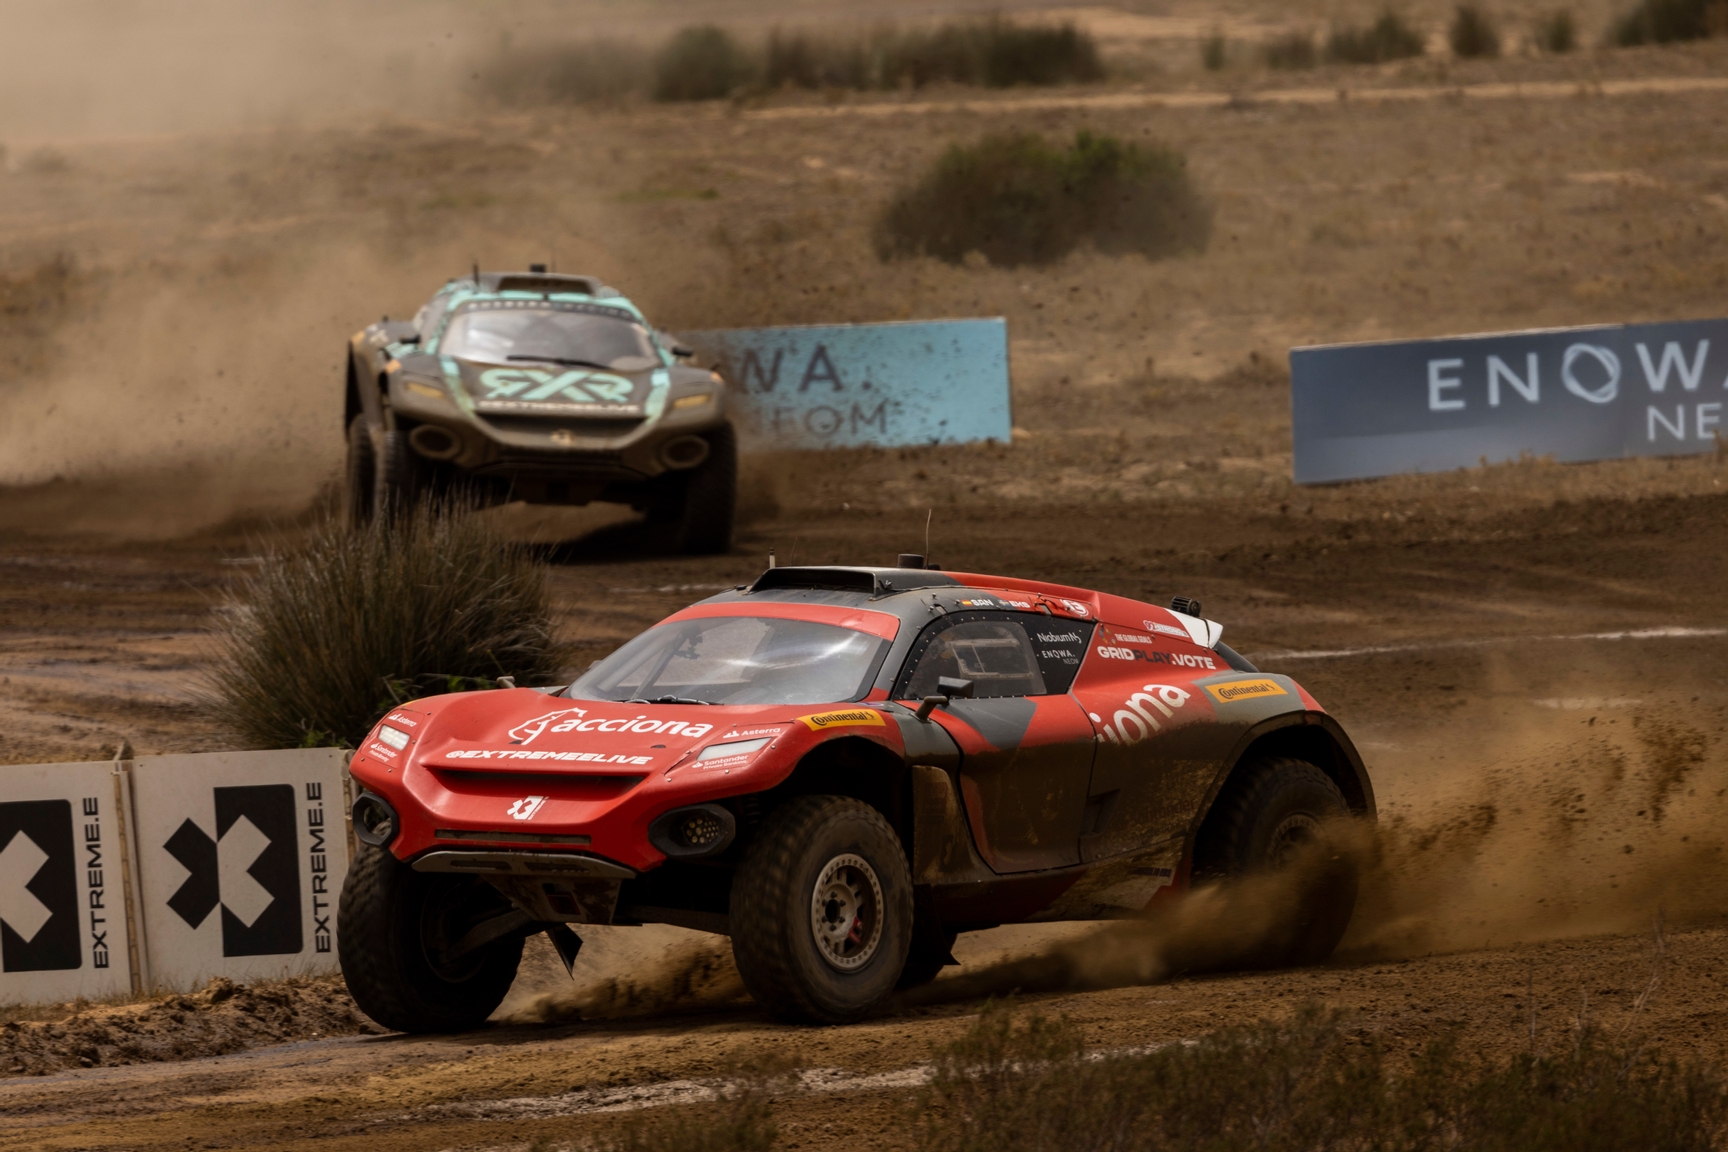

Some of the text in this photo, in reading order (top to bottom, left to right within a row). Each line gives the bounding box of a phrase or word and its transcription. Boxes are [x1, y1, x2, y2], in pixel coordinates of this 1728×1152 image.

[1428, 339, 1728, 411] ENOW
[1097, 645, 1217, 670] GRIDPLAY.VOTE
[1218, 682, 1270, 700] Continental
[550, 715, 713, 738] acciona
[810, 709, 868, 726] Continental
[305, 782, 332, 953] EXTREME.E
[82, 797, 110, 969] EXTREME.E
